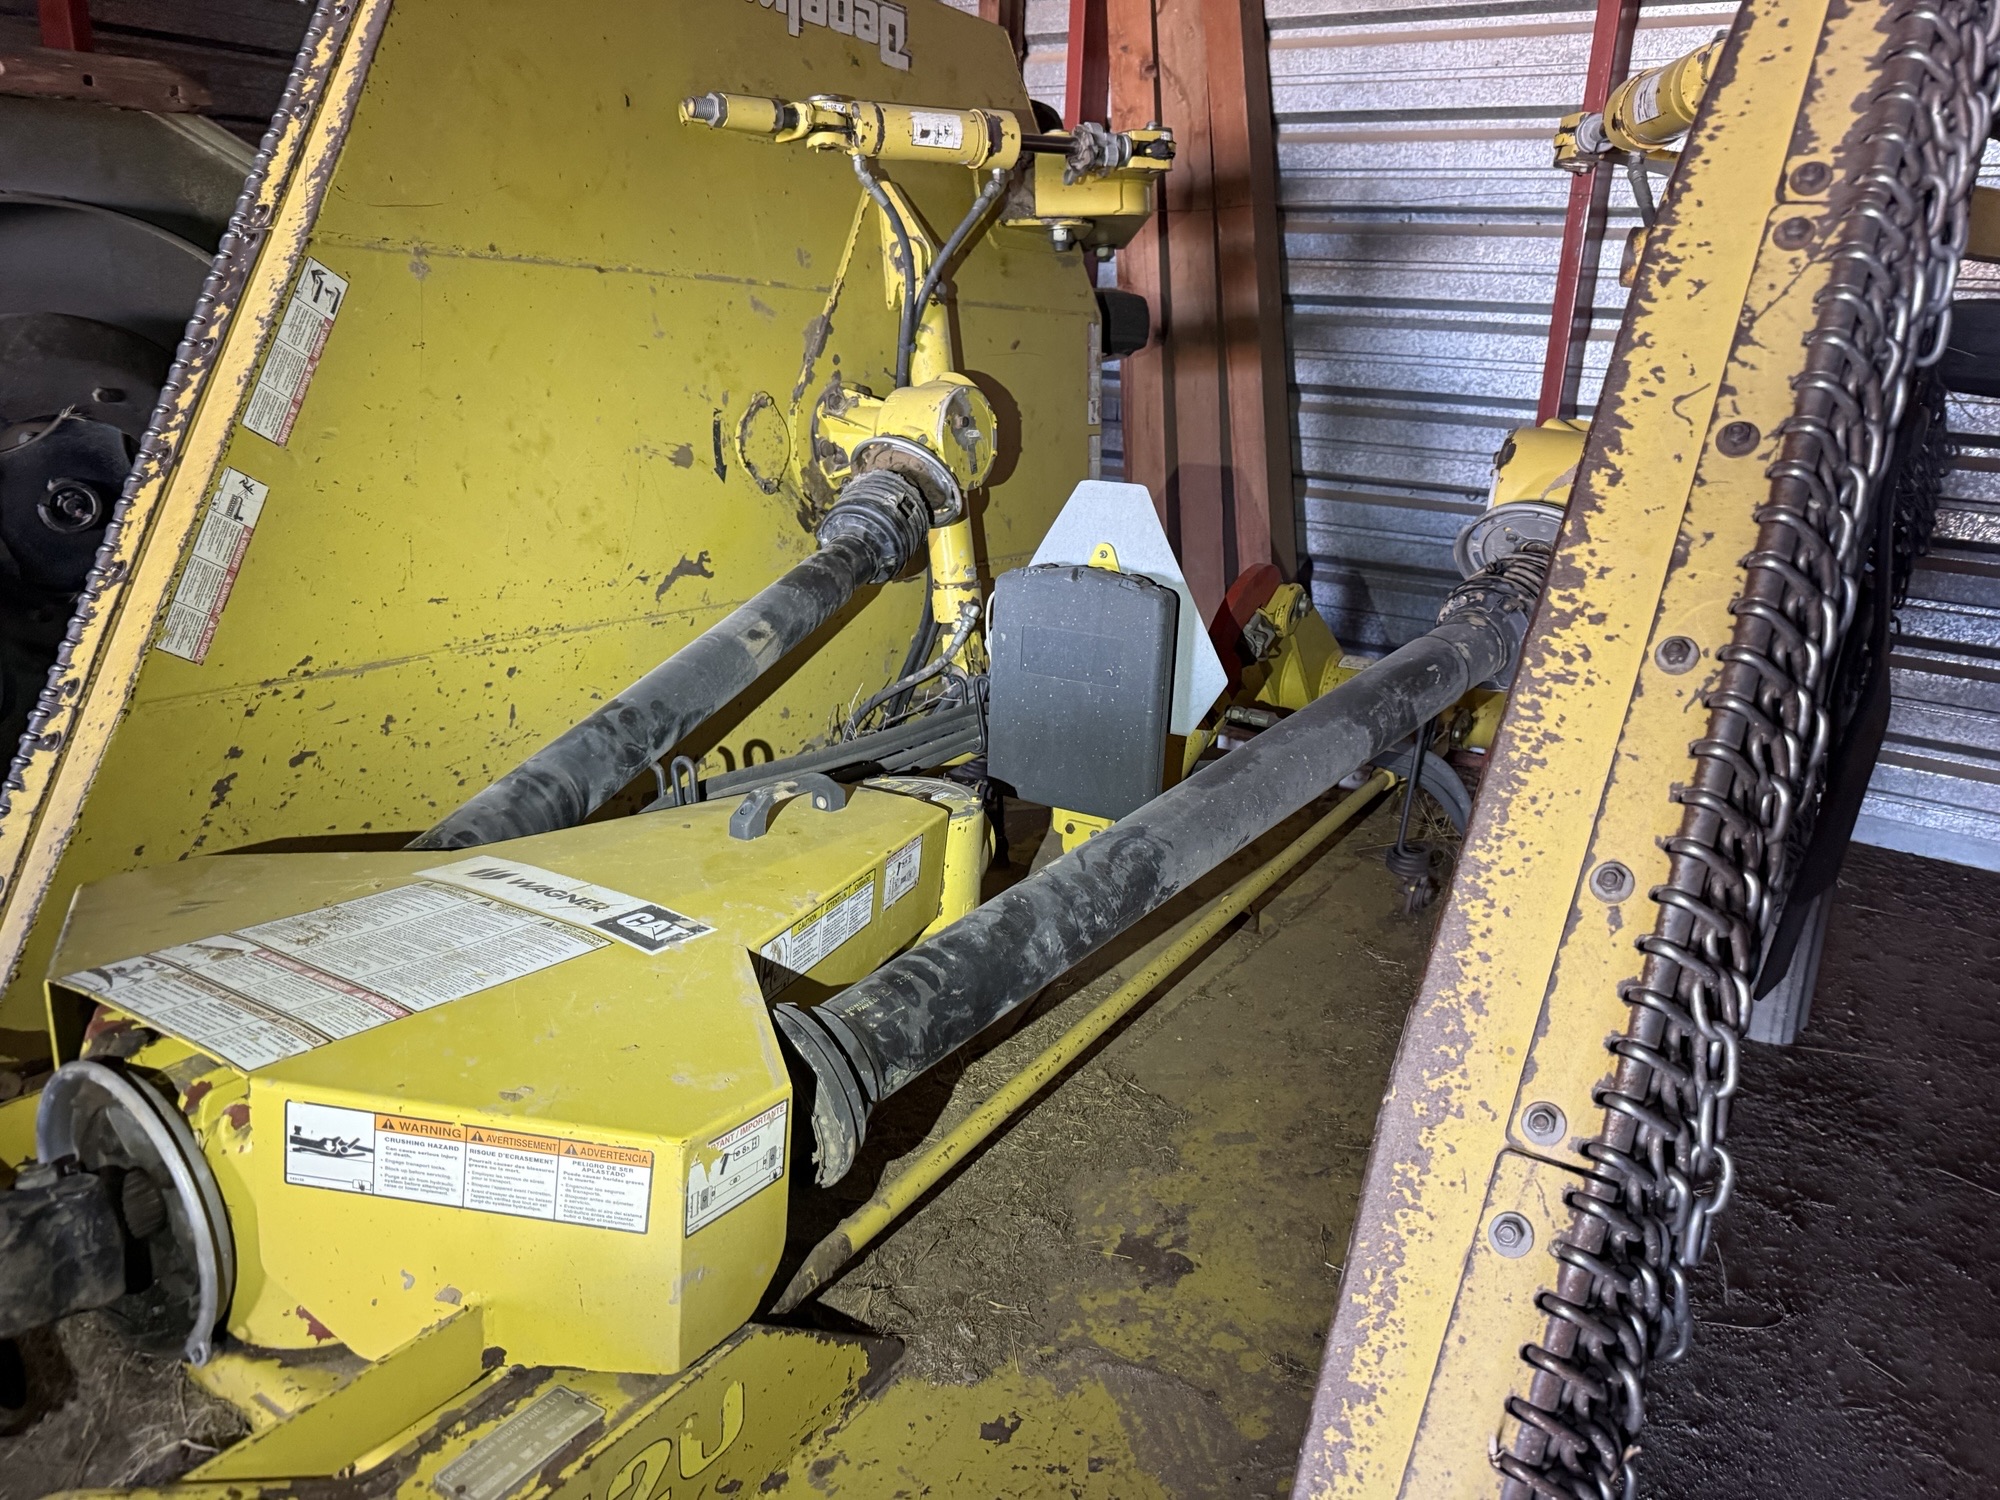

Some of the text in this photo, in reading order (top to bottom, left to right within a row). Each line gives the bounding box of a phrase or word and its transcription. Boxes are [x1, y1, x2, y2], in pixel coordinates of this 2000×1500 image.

[744, 0, 912, 71] Degel
[311, 330, 327, 358] DANGER
[294, 371, 311, 400] DANGER
[278, 413, 294, 443] PELIGRO
[231, 538, 247, 568] DANGER
[213, 583, 230, 614] DANGER
[195, 629, 213, 660] PELIGRO
[507, 878, 610, 913] WAGNER
[617, 912, 691, 942] CAT
[798, 911, 816, 931] CAUTION
[180, 976, 221, 994] WARNING
[359, 995, 407, 1015] PELIGRO
[399, 1122, 462, 1138] WARNING
[739, 1102, 784, 1137] IMPORTANTE
[384, 1137, 459, 1151] CRUSHING HAZARD
[469, 1149, 554, 1165] RISQUE D'ECRASEMENT
[486, 1135, 557, 1151] AVERTISSEMENT
[580, 1147, 648, 1164] ADVERTENCIA
[572, 1161, 604, 1169] PELIGRO
[582, 1168, 626, 1177] APLASTADO
[442, 1440, 498, 1482] DEGELMAN
[493, 1402, 549, 1443] INDUSTRIES
[583, 1382, 745, 1500] 20
